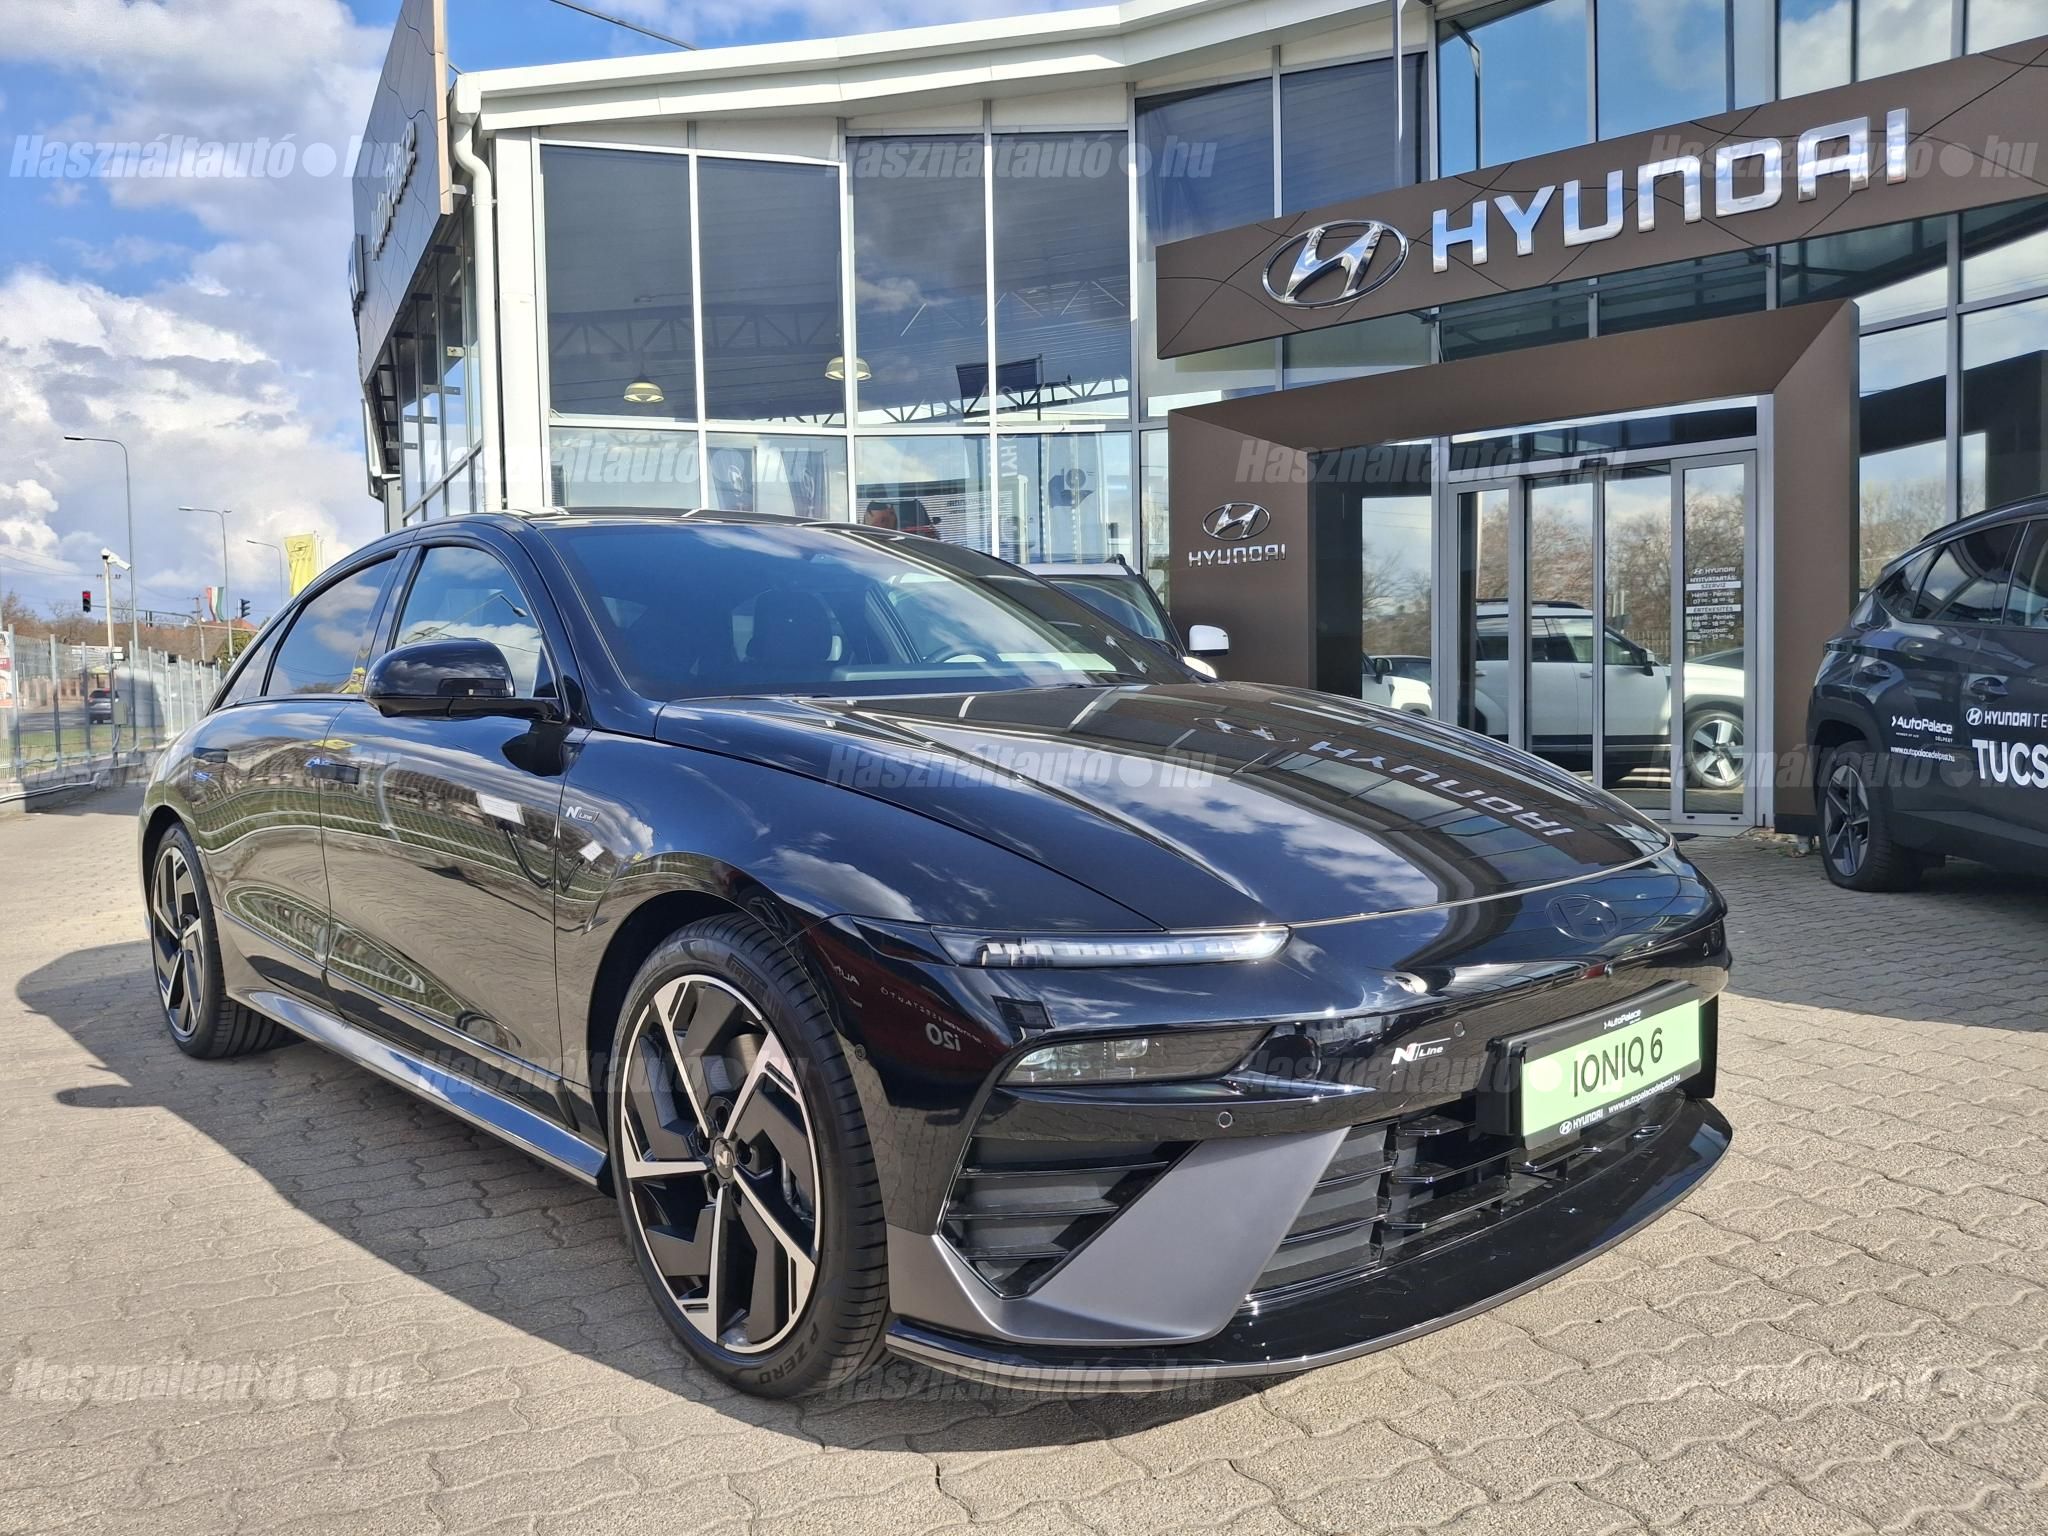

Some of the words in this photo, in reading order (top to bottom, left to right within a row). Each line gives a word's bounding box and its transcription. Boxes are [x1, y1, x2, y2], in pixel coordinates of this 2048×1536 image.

[1432, 107, 1909, 273] HYUNDAI
[1188, 543, 1286, 567] HYUNDAI
[1705, 566, 1736, 574] HYUNDAI
[1897, 715, 1953, 734] AutoPalace
[1984, 710, 2031, 727] HYUNDAI
[1573, 1036, 1644, 1098] IONIQ
[1650, 1027, 1663, 1064] 6
[1573, 1108, 1604, 1130] HYUNDAI
